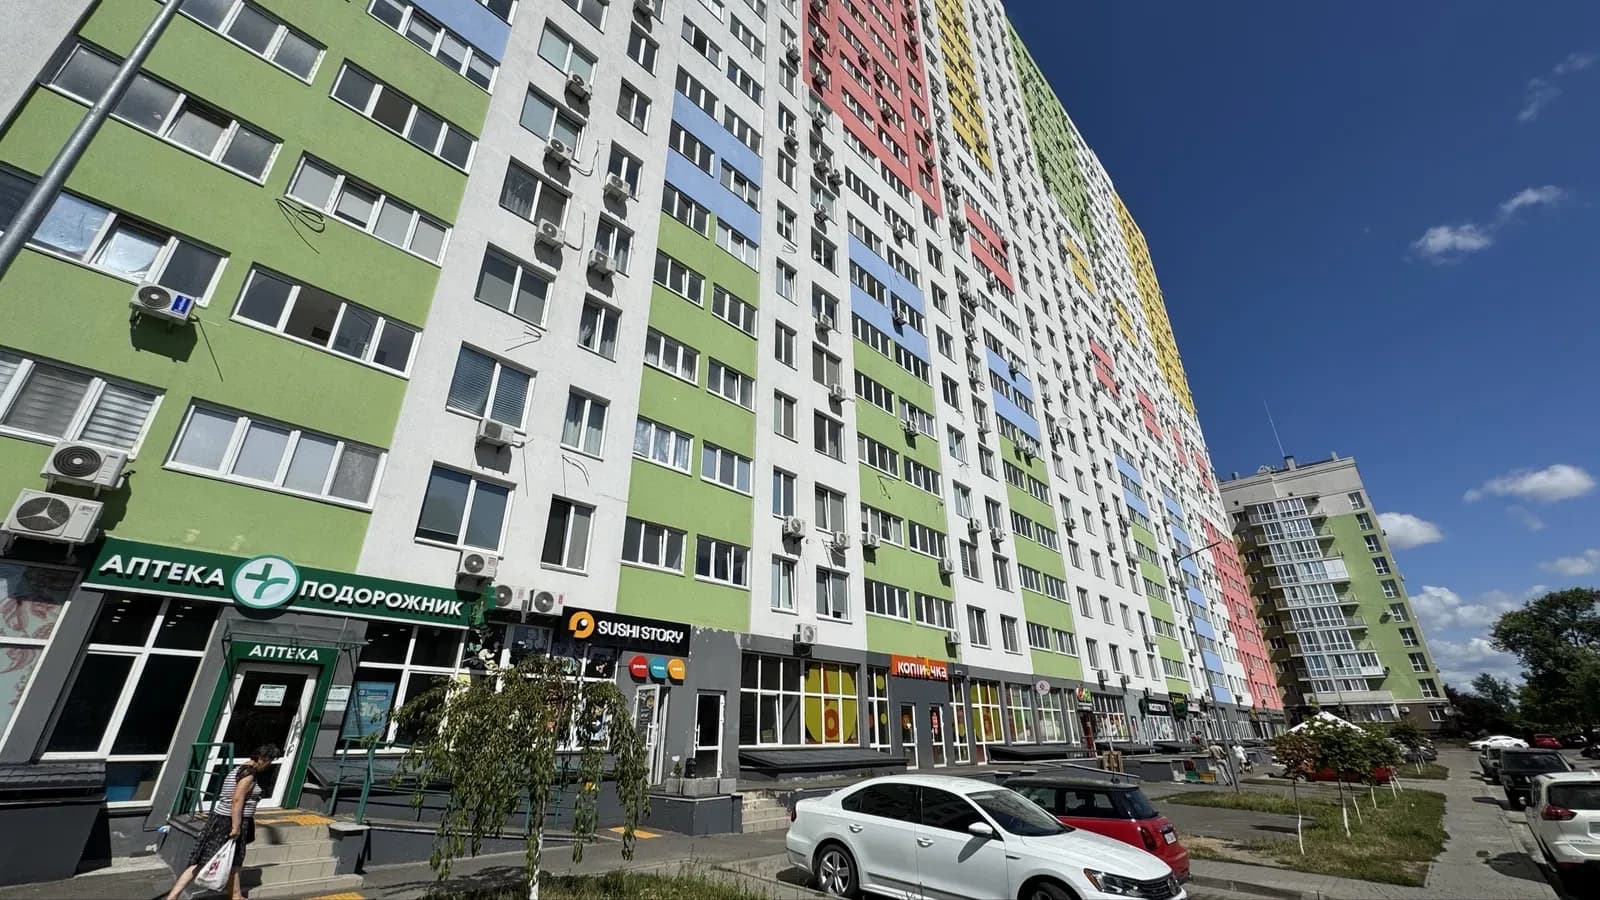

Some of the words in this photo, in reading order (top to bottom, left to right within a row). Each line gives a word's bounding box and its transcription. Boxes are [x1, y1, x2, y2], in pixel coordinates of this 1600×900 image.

[99, 554, 225, 587] АПТЕКА
[299, 580, 464, 617] ПОДОРОЖНИК
[597, 620, 640, 639] SUSHI
[641, 626, 684, 644] STORY
[248, 644, 320, 662] АПТЕКА
